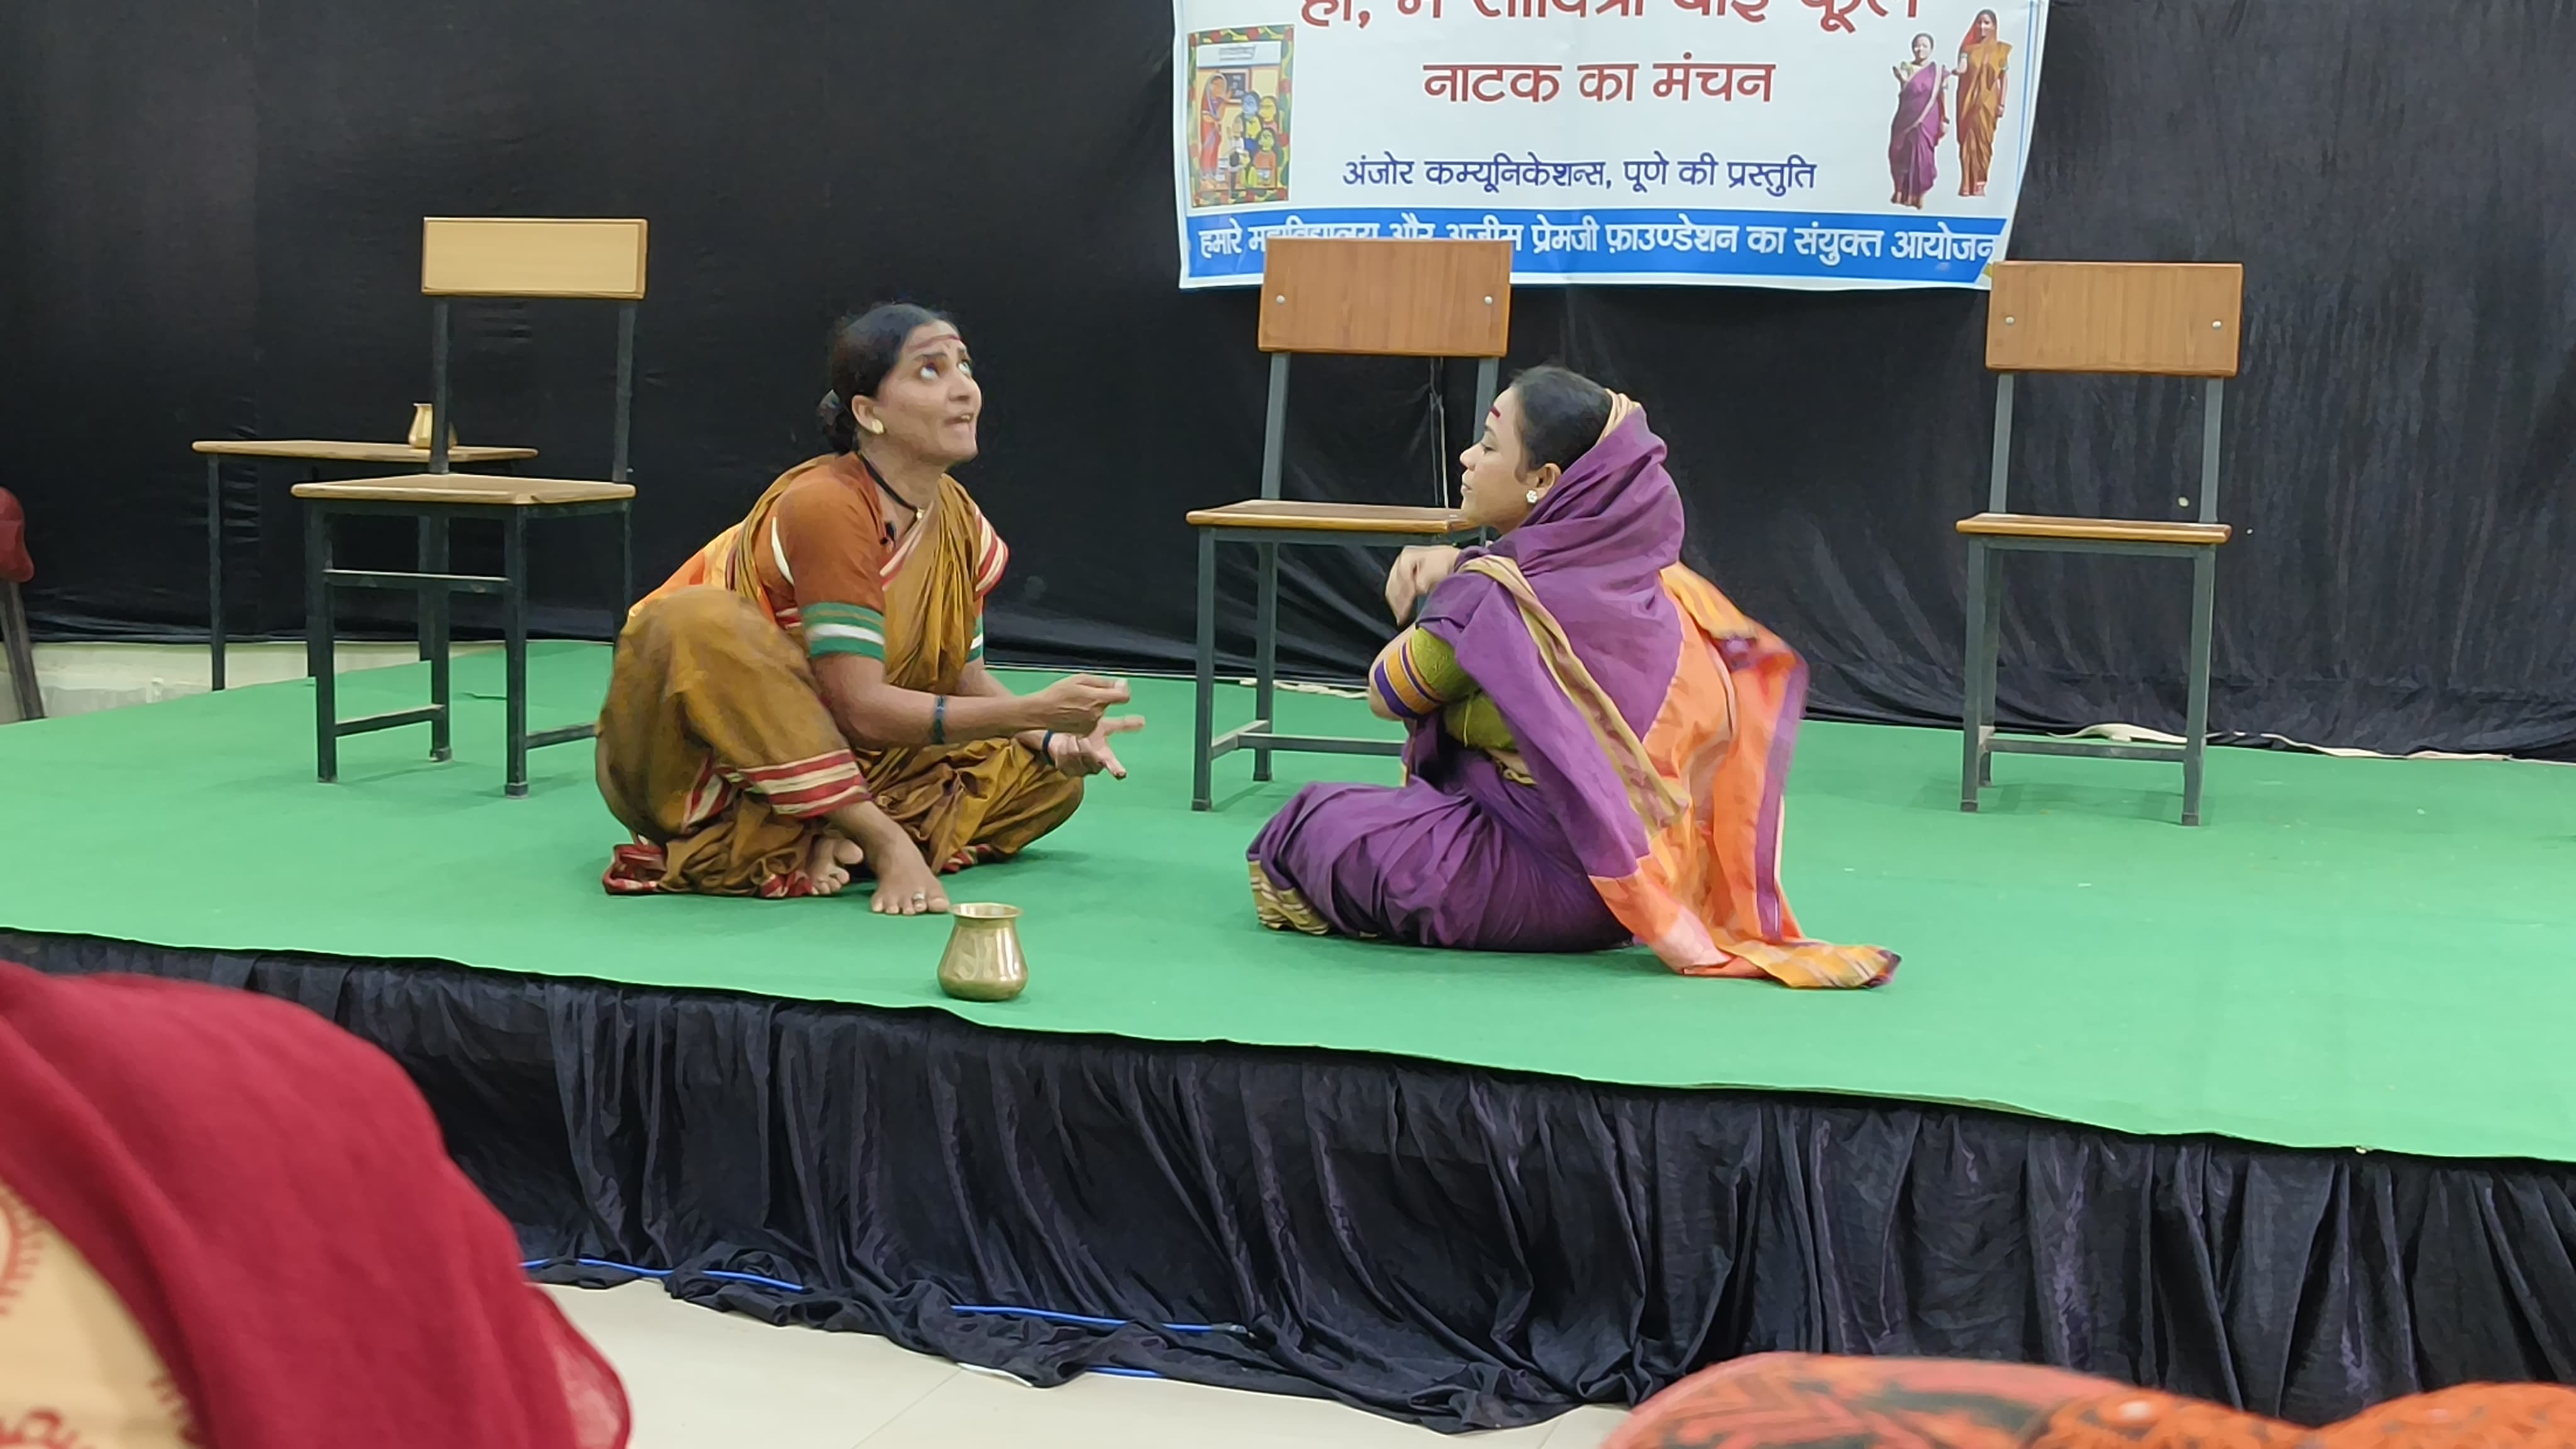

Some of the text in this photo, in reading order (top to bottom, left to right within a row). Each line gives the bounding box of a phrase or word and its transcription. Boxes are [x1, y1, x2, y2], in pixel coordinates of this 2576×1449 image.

[1423, 52, 1776, 102] नाटक का मंचन
[1343, 150, 1817, 197] अंजोर कम्यूनिकेशन्स, पूणे की प्रस्तुति
[1198, 218, 1243, 258] हमारे
[1531, 214, 1600, 253] प्रेमजी
[1605, 213, 1740, 253] फ़ाउण्डेशन
[1746, 226, 1787, 254] का
[1794, 221, 1885, 265] संयुक्त
[1891, 221, 1997, 261] आयोजन
